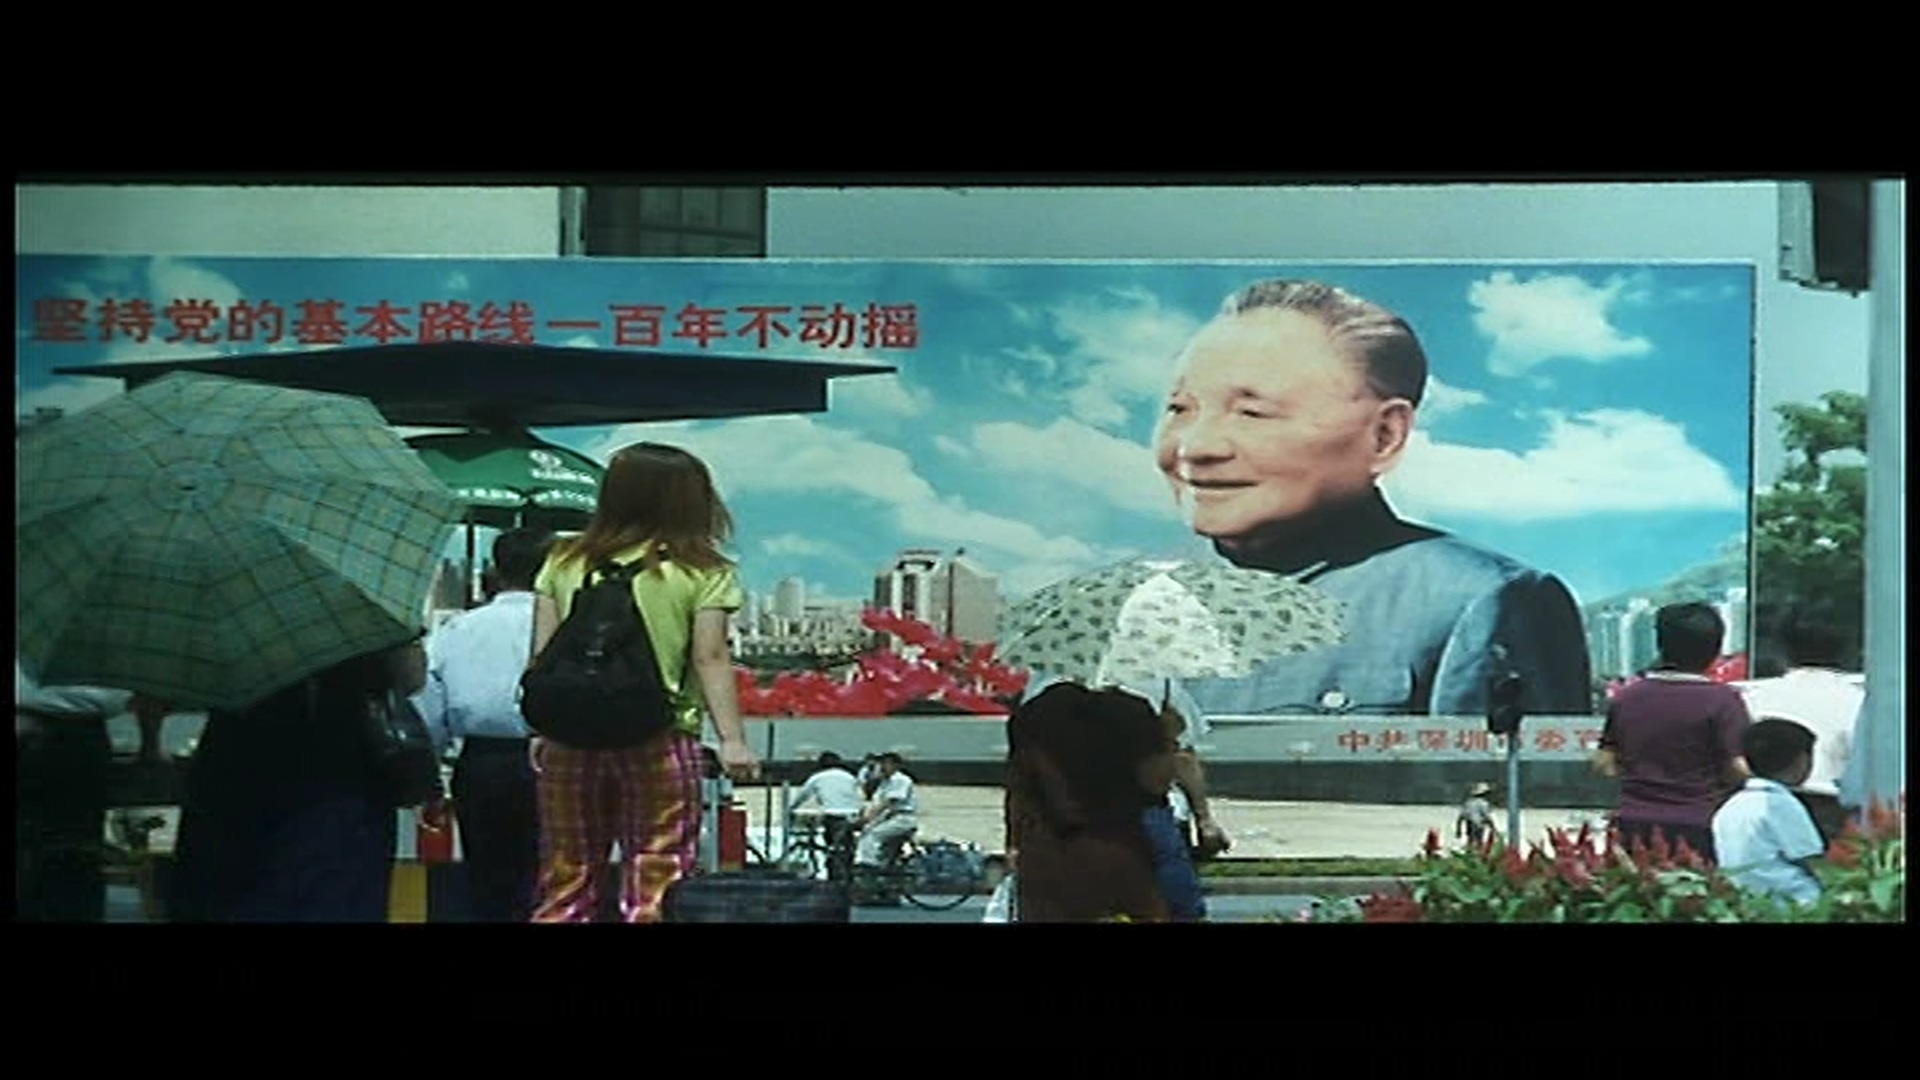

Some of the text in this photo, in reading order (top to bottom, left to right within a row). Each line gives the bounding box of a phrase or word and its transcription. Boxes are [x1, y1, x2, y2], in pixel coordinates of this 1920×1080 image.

[33, 297, 918, 349] 坚持党的基本路线一百年不动摇
